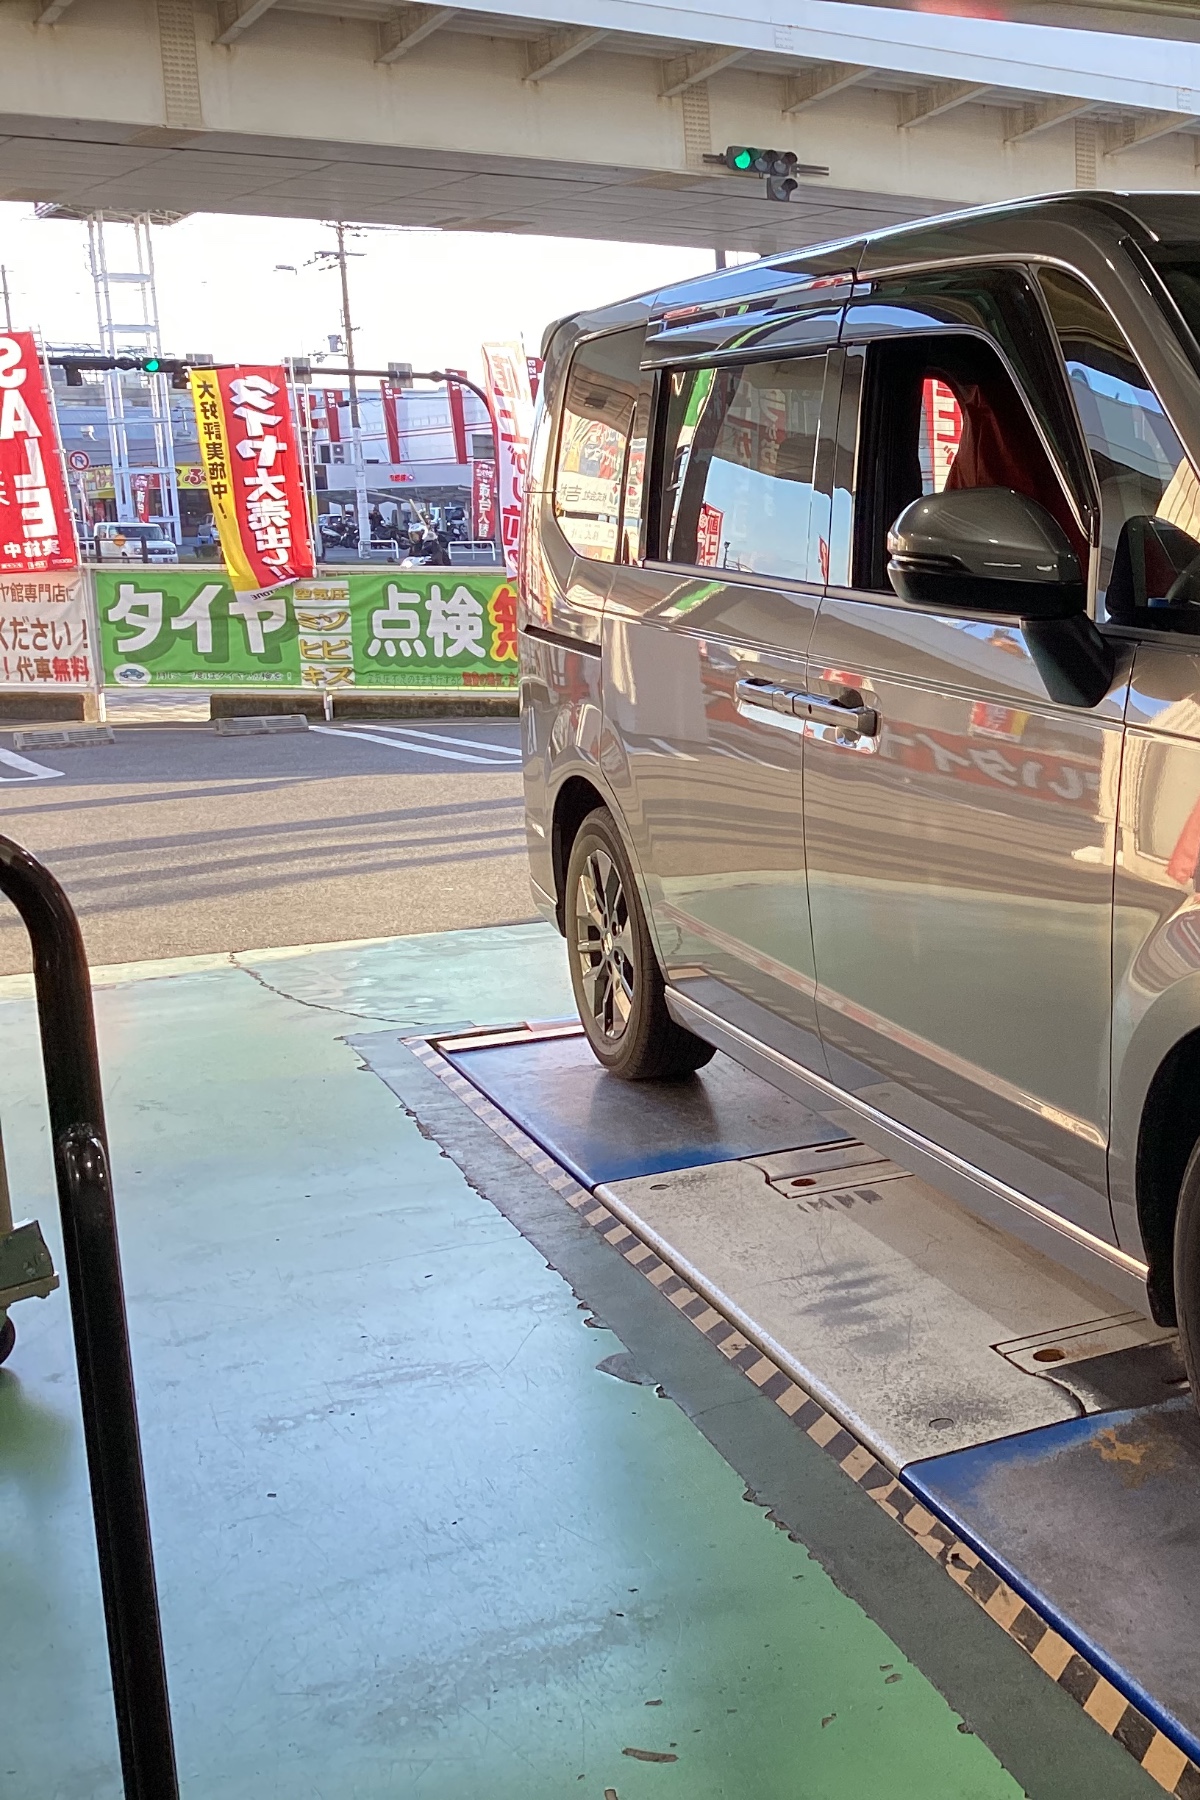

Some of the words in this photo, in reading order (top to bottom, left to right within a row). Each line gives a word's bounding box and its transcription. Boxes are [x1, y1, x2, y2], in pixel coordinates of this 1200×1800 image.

[527, 360, 537, 380] 123
[295, 588, 349, 600] 空気圧
[108, 584, 286, 653] タイヤ
[298, 611, 350, 631] ミゾ
[300, 639, 352, 659] ヒビ
